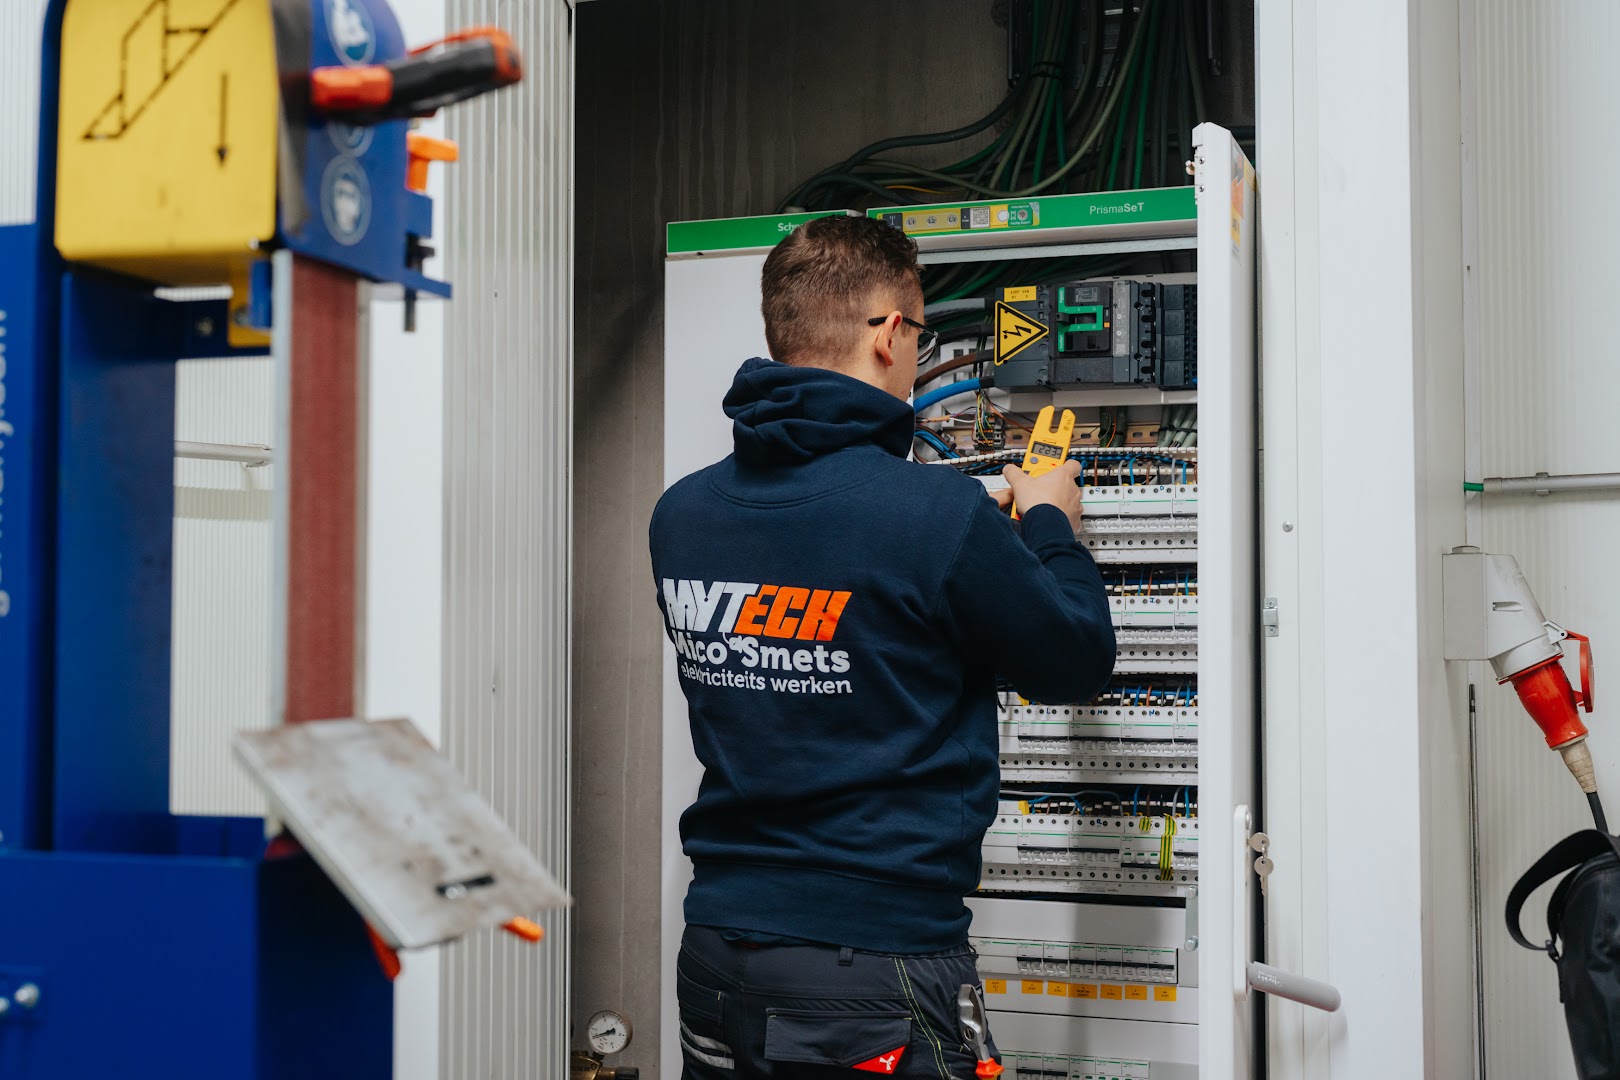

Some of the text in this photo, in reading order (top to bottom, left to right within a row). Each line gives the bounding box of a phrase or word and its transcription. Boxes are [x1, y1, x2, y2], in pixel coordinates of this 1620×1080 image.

[1089, 202, 1144, 215] PrismaSeT
[662, 577, 853, 642] MYTECH
[671, 629, 851, 673] Nico Smets
[770, 675, 853, 694] werken
